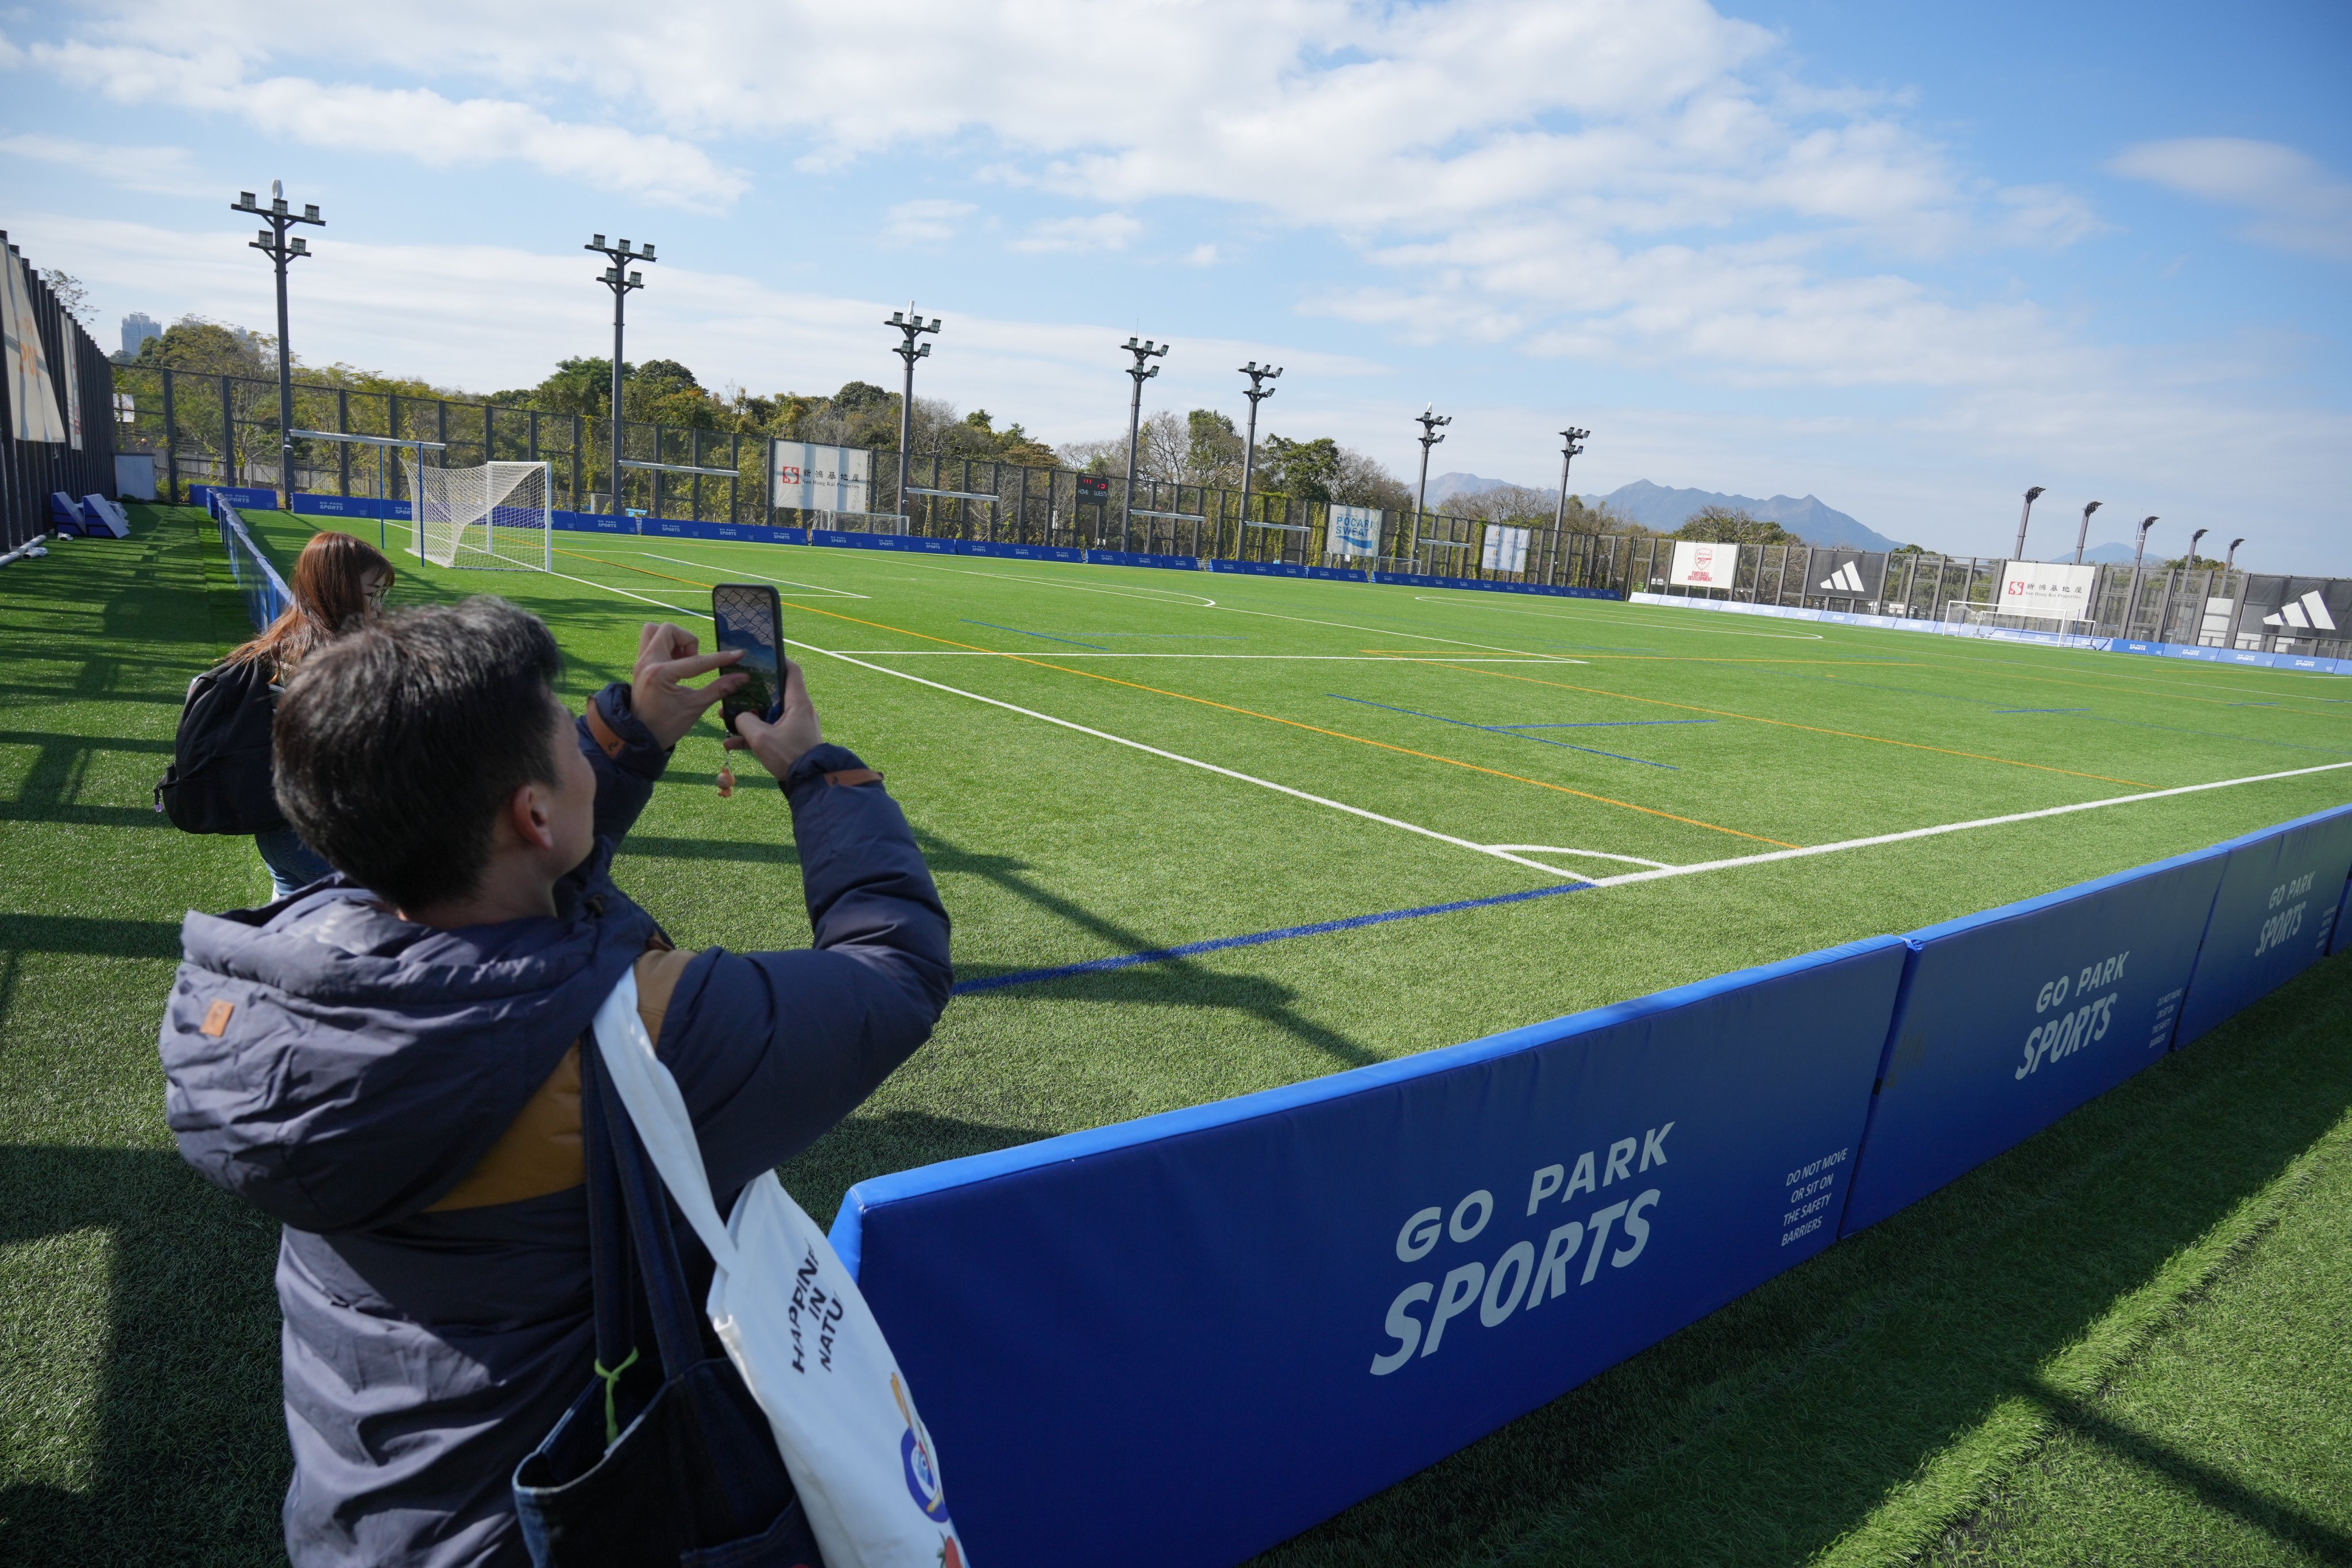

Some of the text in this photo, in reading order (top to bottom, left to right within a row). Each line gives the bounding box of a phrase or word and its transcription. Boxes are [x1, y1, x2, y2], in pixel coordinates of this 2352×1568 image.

[1336, 526, 1369, 537] SWEAT
[1337, 516, 1373, 528] POCARI
[2269, 871, 2316, 910] GO PARK
[2254, 901, 2307, 957] SPORTS
[2036, 951, 2130, 1013] GO PARK
[2015, 992, 2118, 1080] SPORTS
[1786, 1148, 1848, 1187] DO NOT MOVE
[1396, 1121, 1675, 1263] GO PARK
[1791, 1173, 1834, 1203] OR SIT ON
[1783, 1193, 1832, 1227] THE SAFETY
[1781, 1216, 1822, 1247] BARRIERS
[1369, 1188, 1661, 1376] SPORTS
[809, 1287, 827, 1321] IN
[819, 1292, 844, 1373] NATU
